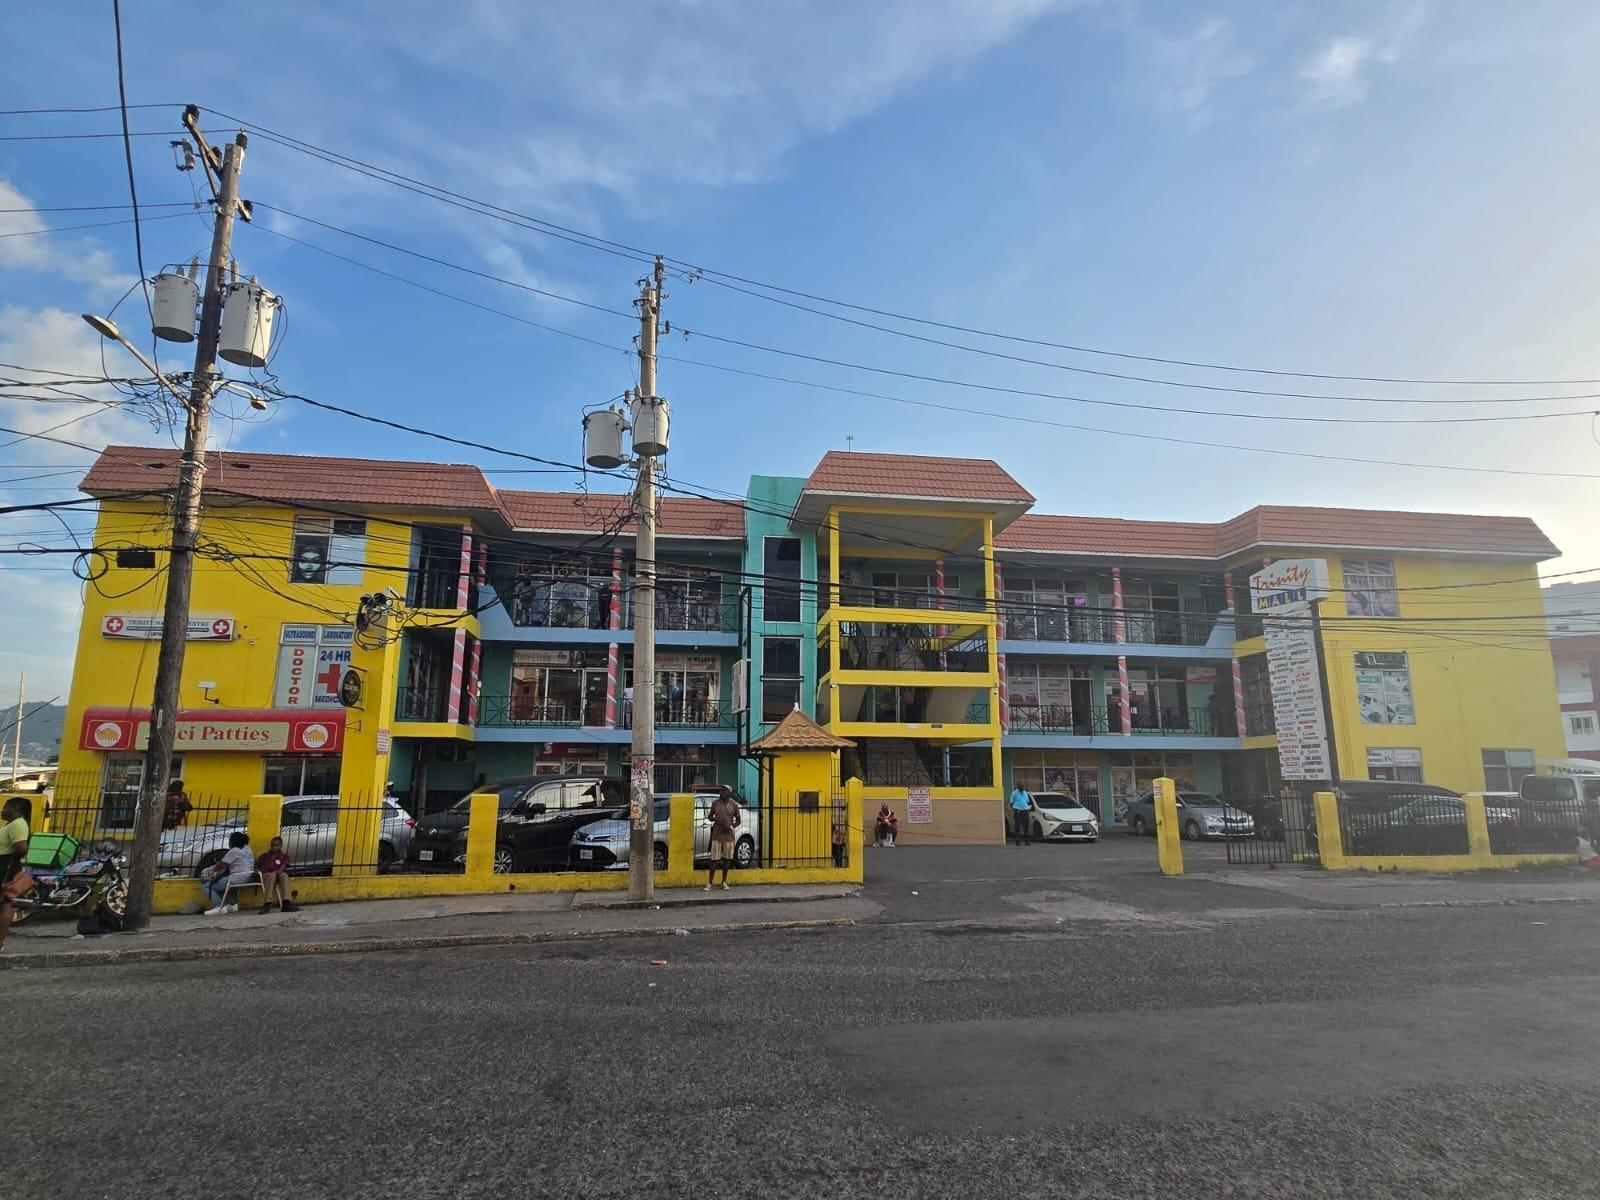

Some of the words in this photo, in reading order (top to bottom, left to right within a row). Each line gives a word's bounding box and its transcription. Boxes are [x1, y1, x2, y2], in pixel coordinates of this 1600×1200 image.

[1258, 591, 1305, 609] MALL
[320, 651, 332, 661] 24
[335, 651, 351, 661] HR
[288, 648, 304, 705] DOCTOR
[201, 725, 270, 741] Patties
